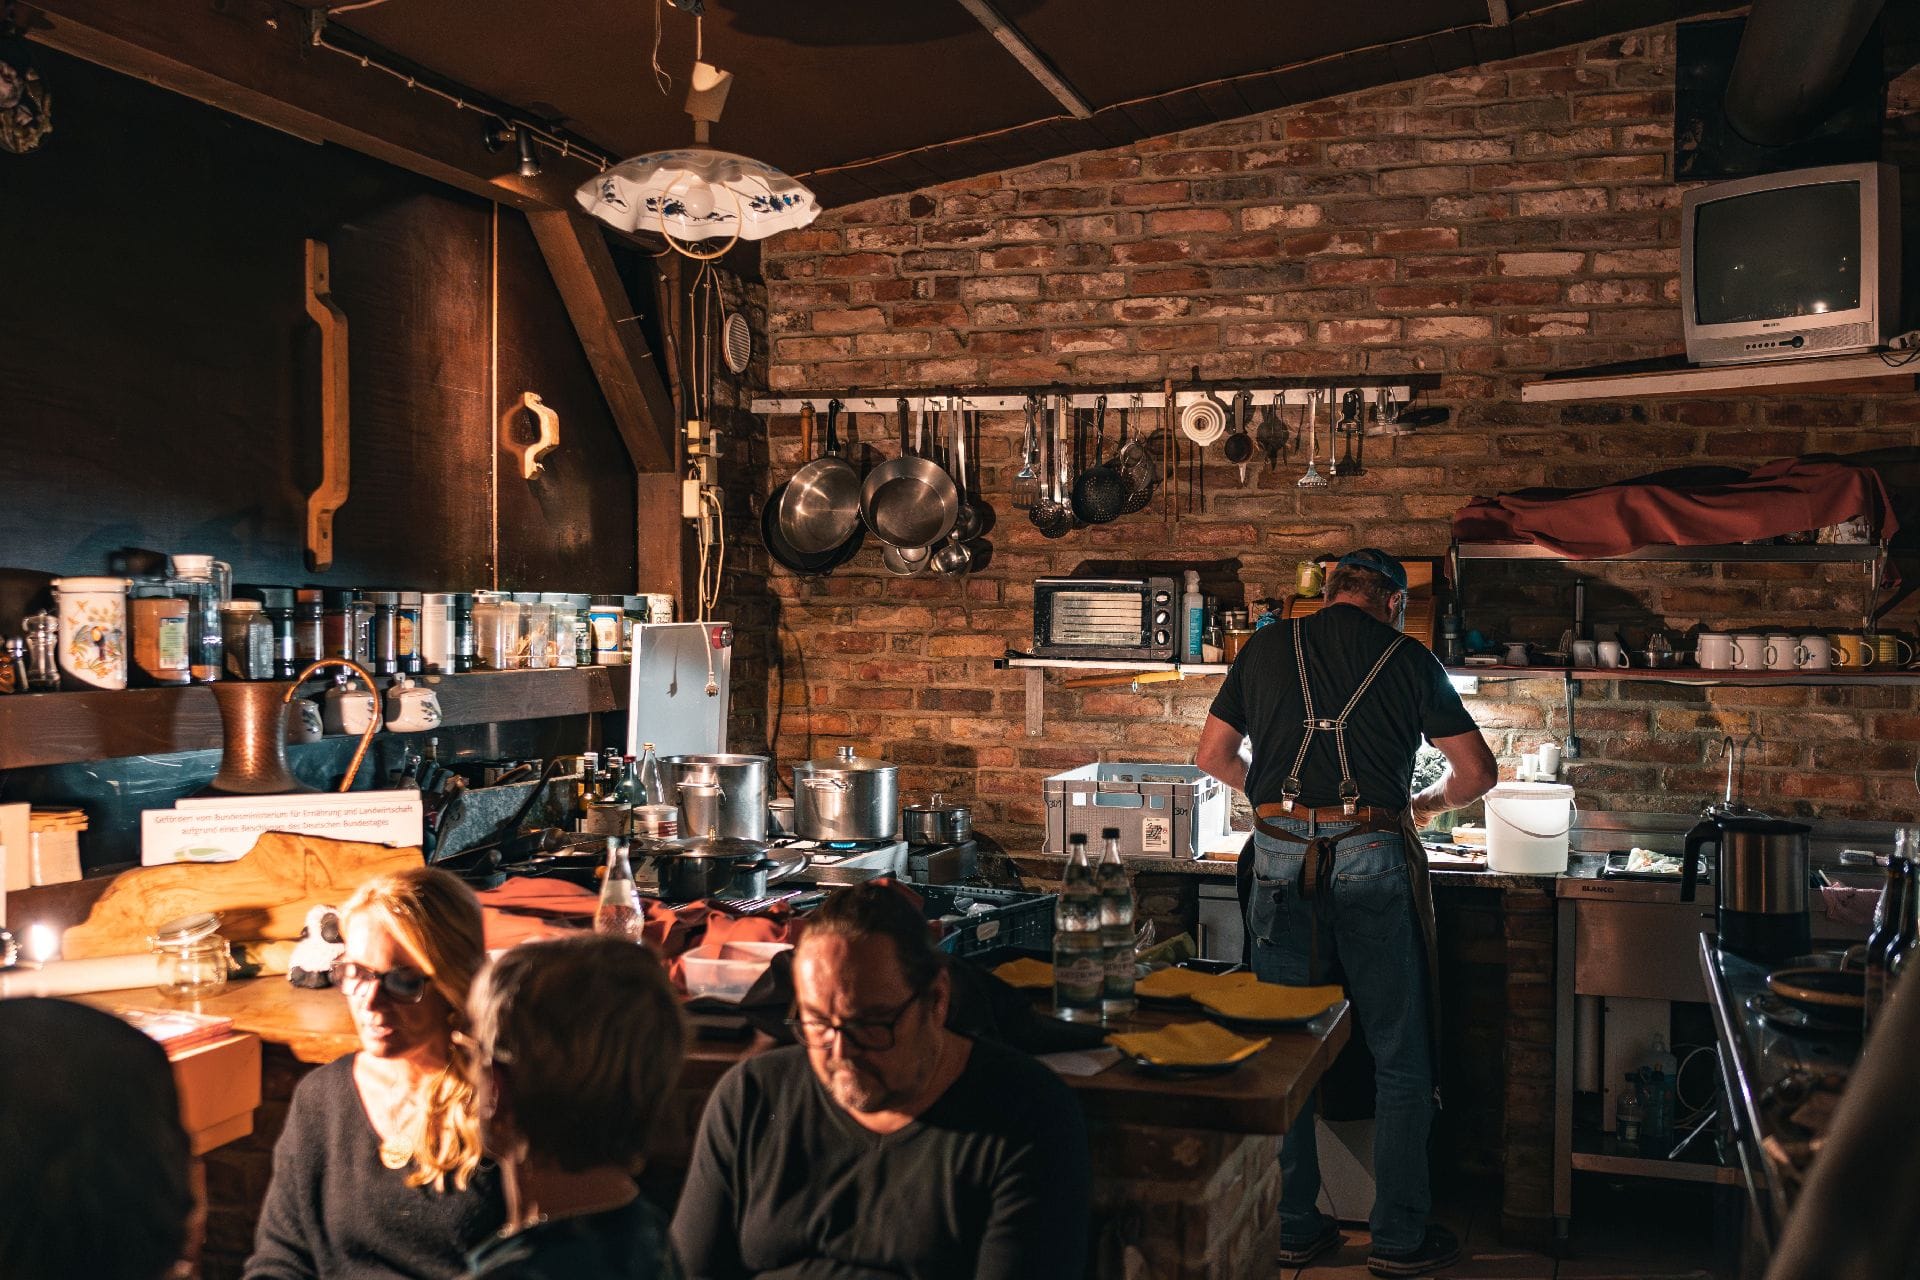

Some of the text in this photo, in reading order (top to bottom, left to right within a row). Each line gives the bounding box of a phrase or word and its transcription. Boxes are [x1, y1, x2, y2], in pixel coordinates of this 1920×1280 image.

[215, 811, 288, 821] Bundesministerium
[291, 809, 300, 817] für
[304, 809, 341, 817] Ernährung
[360, 805, 413, 814] Landwirtschaft
[182, 826, 217, 836] aufgrund
[304, 821, 341, 829] Deutschen
[344, 819, 390, 828] Bundestages
[1582, 885, 1615, 893] BLANCO
